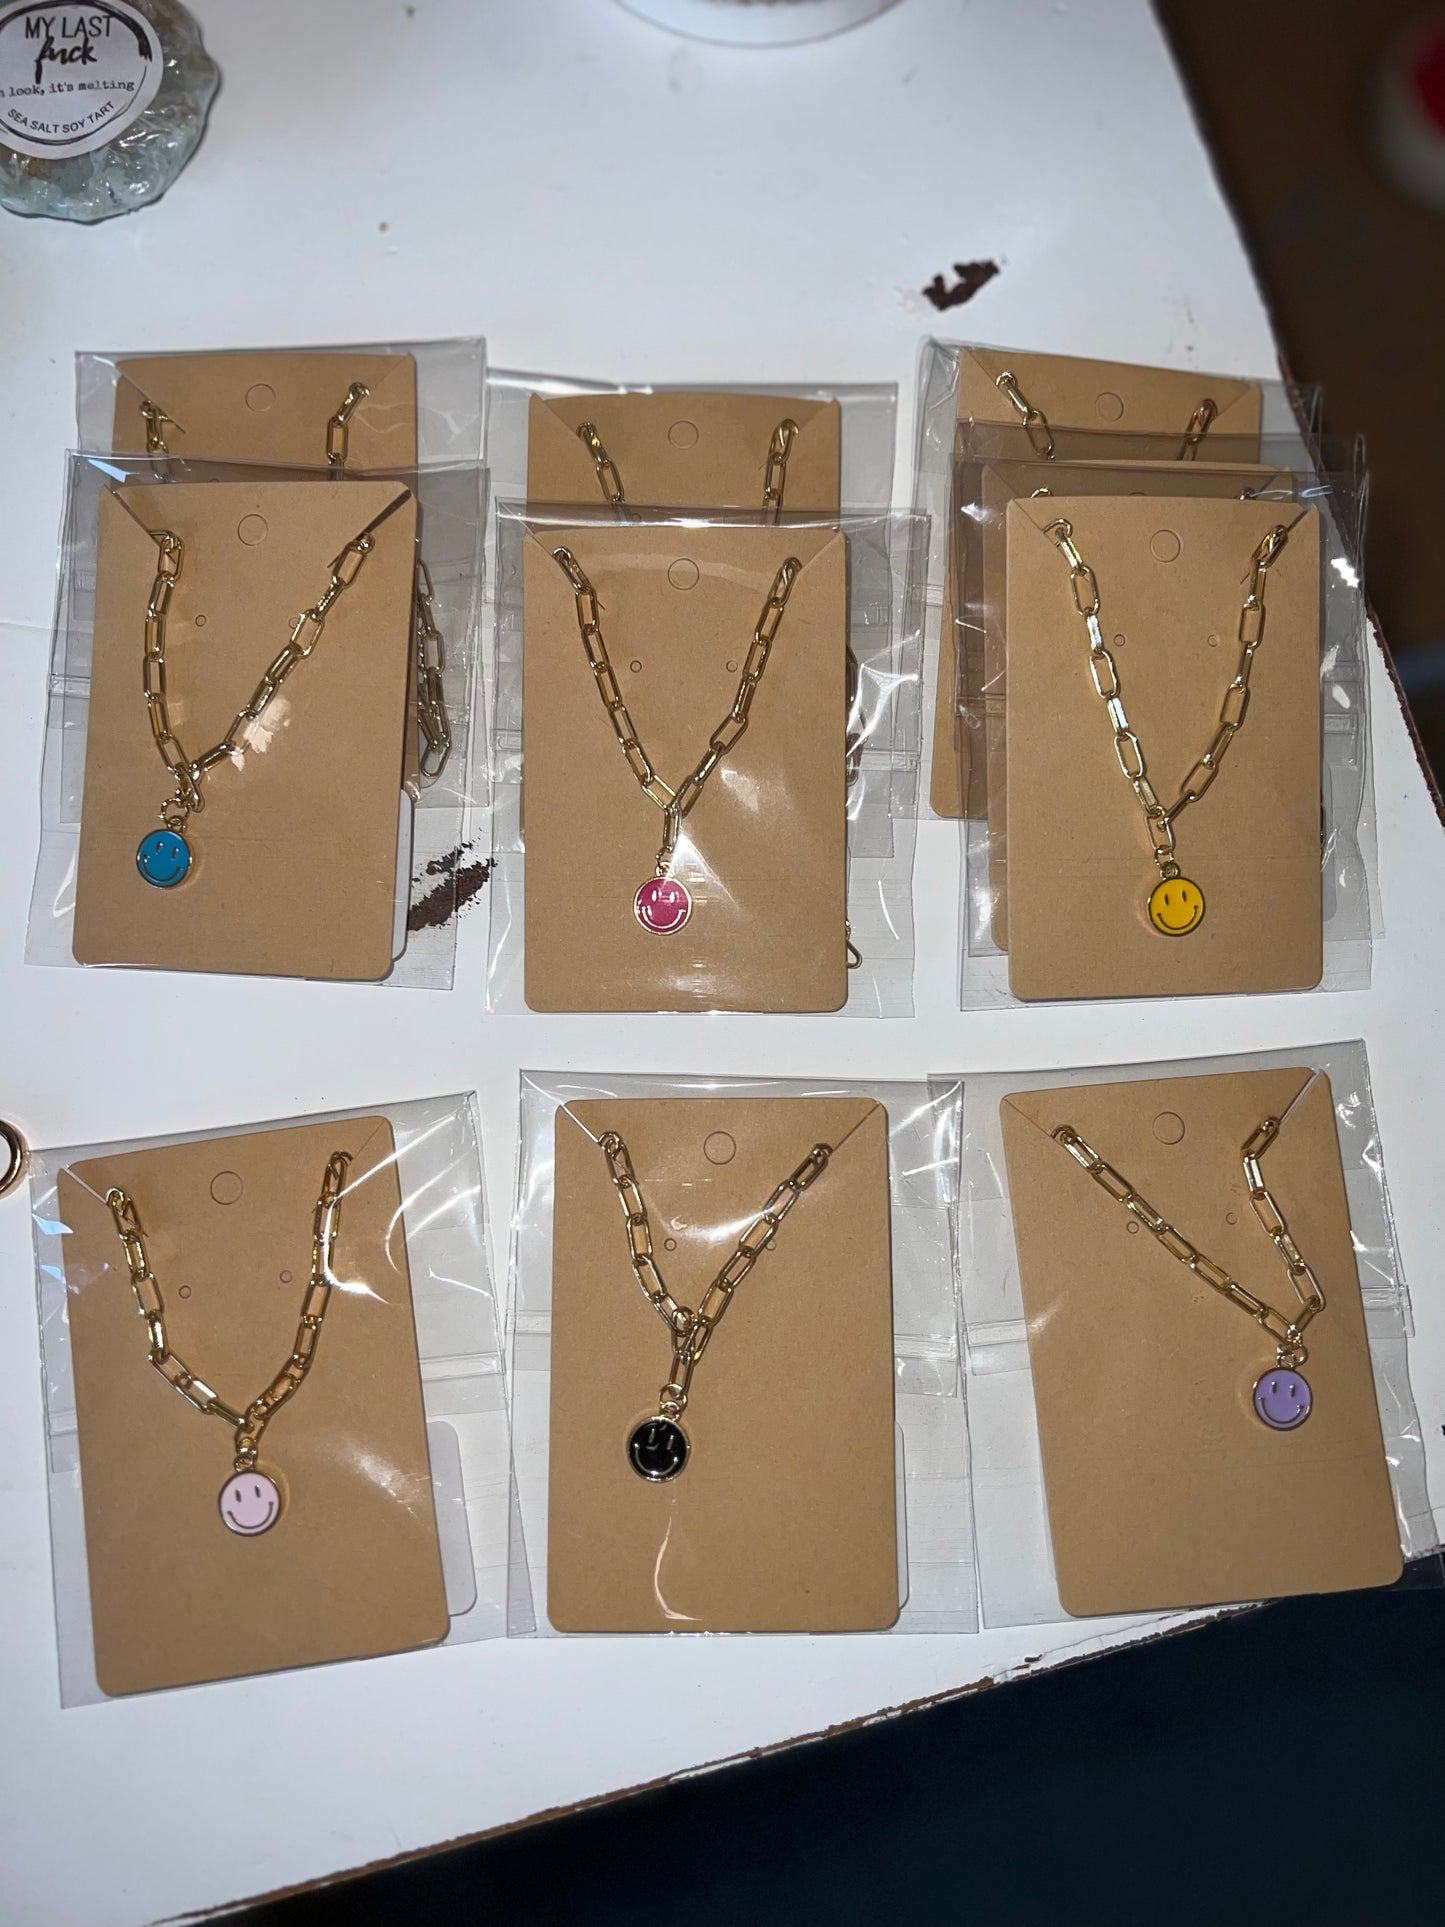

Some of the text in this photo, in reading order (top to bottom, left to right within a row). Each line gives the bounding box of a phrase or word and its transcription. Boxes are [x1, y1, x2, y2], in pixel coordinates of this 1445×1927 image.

[25, 15, 112, 39] MY LAST
[34, 35, 98, 84] fuck
[9, 85, 45, 97] look,
[49, 81, 74, 93] it's
[78, 80, 135, 92] melting
[8, 100, 114, 133] SEA SALT SOY TART
